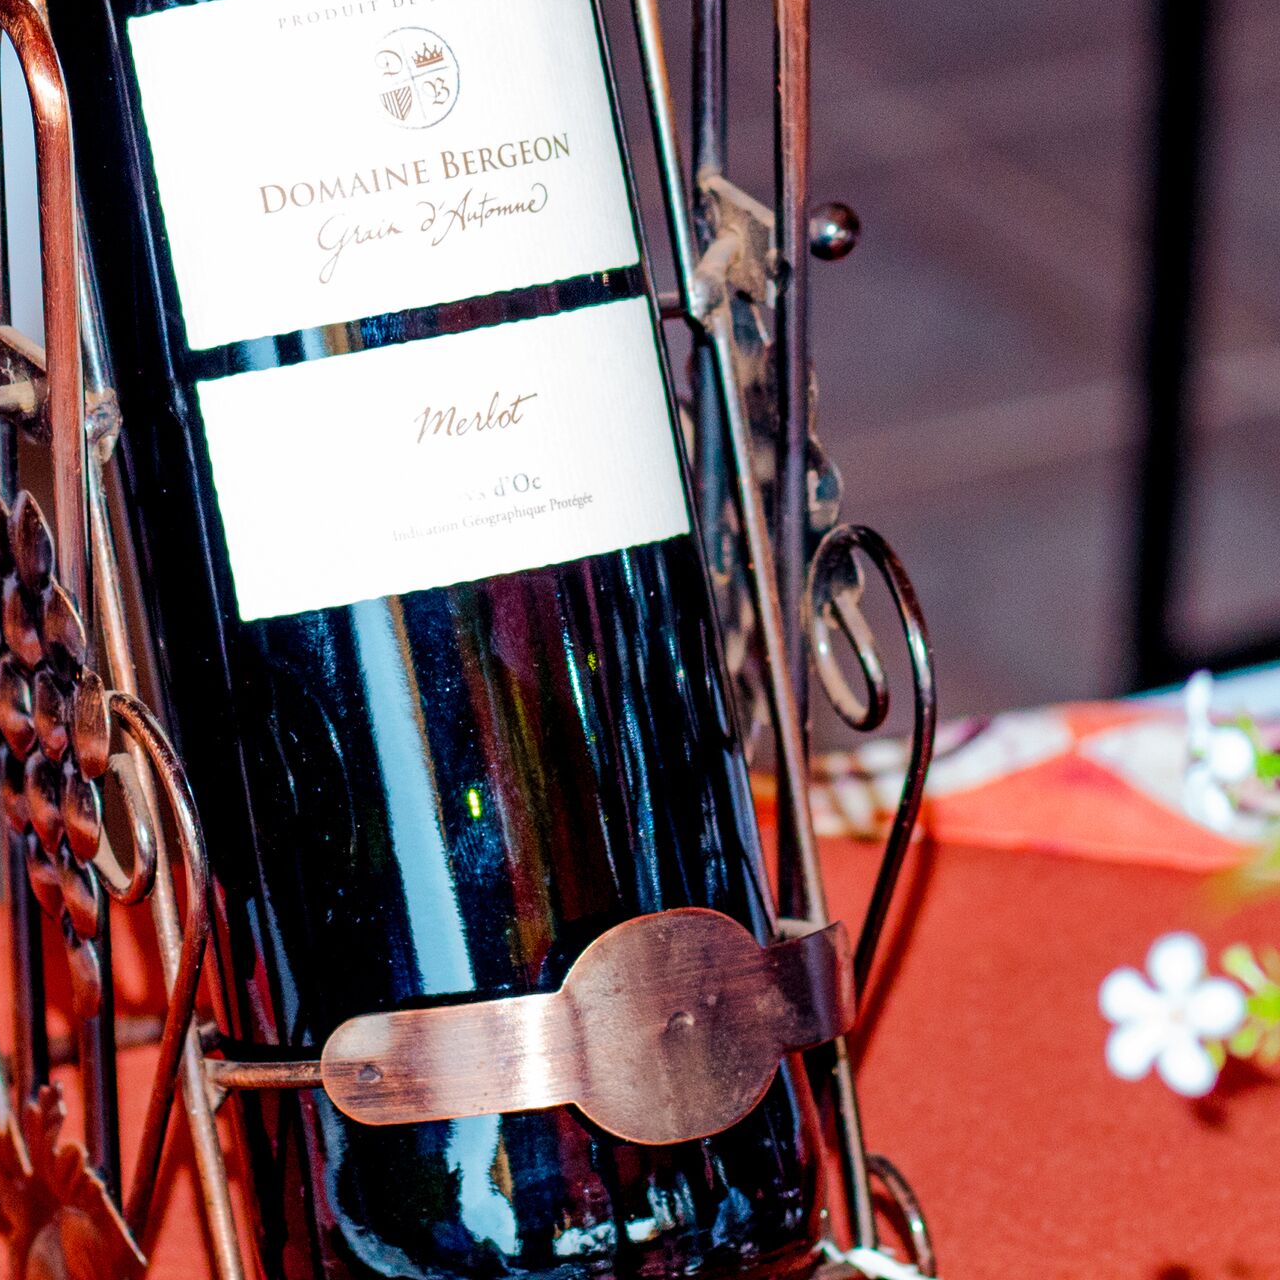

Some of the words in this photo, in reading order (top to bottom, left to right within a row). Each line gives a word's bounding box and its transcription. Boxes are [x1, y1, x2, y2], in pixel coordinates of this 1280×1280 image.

[279, 0, 378, 29] PRODUIT
[259, 159, 430, 214] DOMAINE
[440, 133, 571, 180] BERGEON
[317, 213, 404, 284] Grain
[416, 182, 548, 247] d'Automne
[414, 392, 538, 445] Merlot
[549, 492, 594, 513] Protégée
